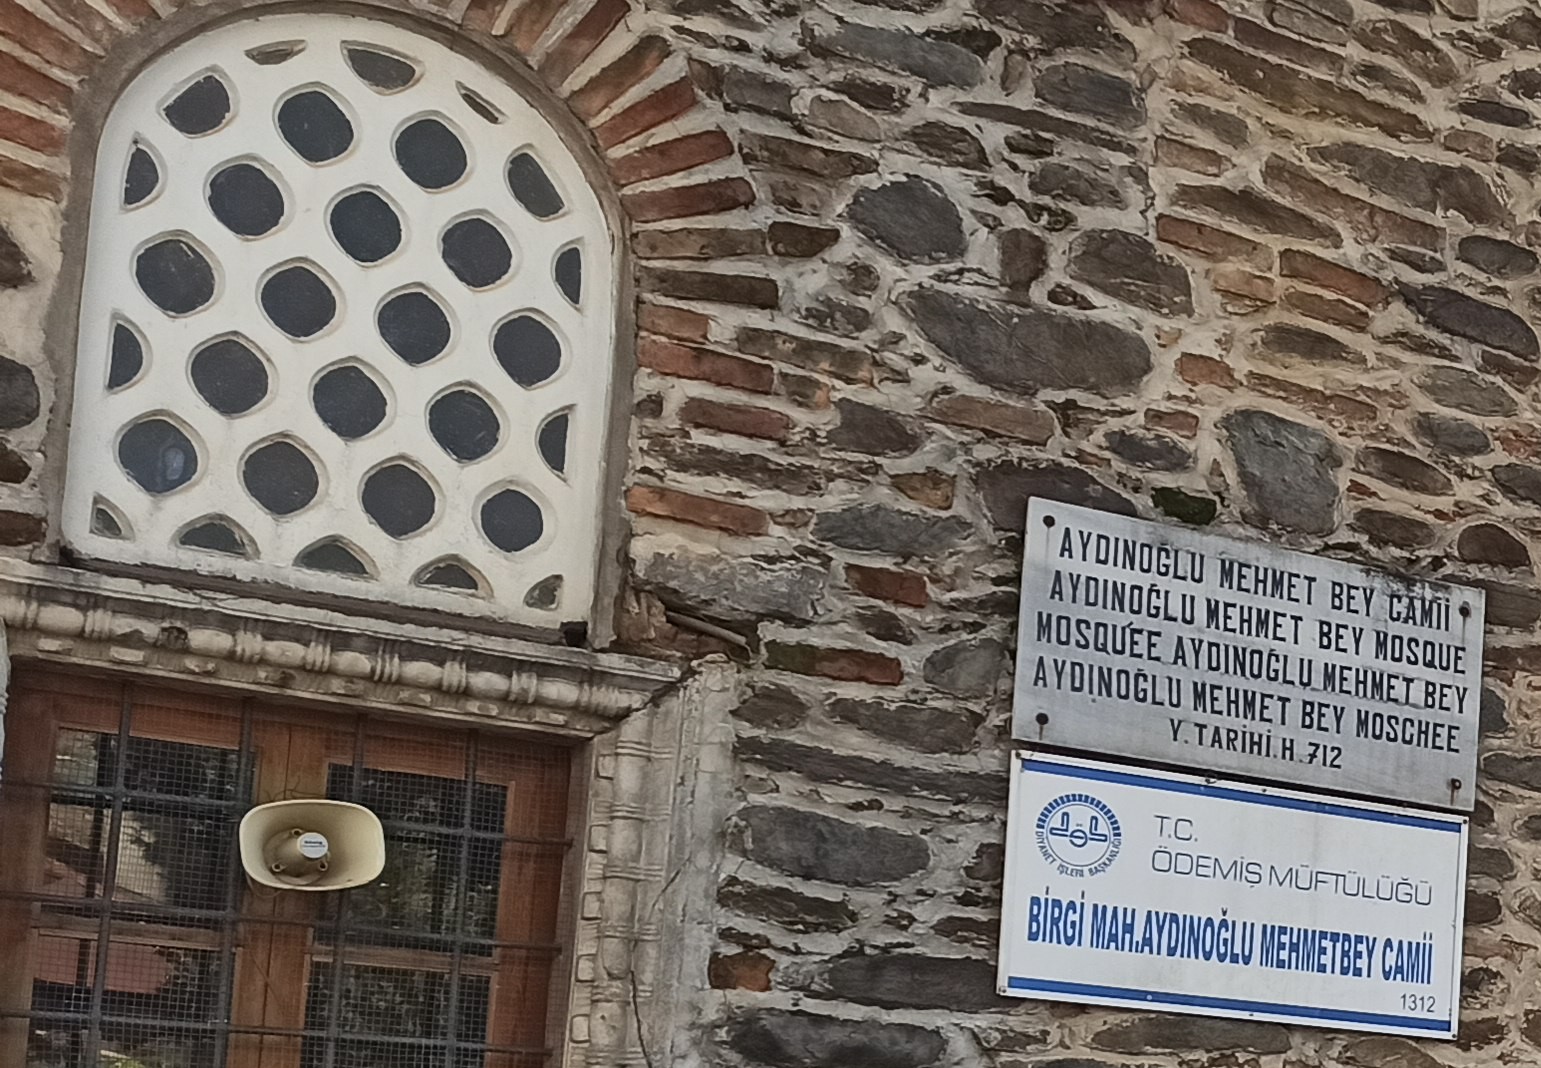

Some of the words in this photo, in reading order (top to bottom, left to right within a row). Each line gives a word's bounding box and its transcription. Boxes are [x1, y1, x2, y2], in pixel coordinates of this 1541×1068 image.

[1050, 570, 1195, 625] AYDINOĞLU
[1206, 598, 1303, 644] MEHMET
[1319, 620, 1364, 655] BEY
[1374, 630, 1466, 674] MOSQUE
[1060, 527, 1204, 583] AYDINOĞLU
[1220, 559, 1316, 605] MEHMET
[1332, 581, 1374, 617] BEY
[1388, 594, 1450, 632] CAMİİ
[1033, 656, 1181, 708] AYDINOĞLU
[1193, 681, 1291, 725] MEHMET
[1302, 699, 1345, 734] BEY
[1356, 709, 1460, 753] MOSCHEE
[1037, 611, 1161, 662] MOSQUÉE
[1172, 636, 1312, 689] AYDINOĞLU
[1323, 663, 1417, 708] MEHMET
[1424, 681, 1467, 713] BEY
[1152, 845, 1262, 888] ÖDEMİŞ
[1269, 864, 1433, 906] MÜFTÜLÜĞÜ
[1154, 815, 1198, 842] T.C.
[1027, 886, 1084, 947] BİRGİ
[1260, 923, 1377, 979] MEHMETBEY
[1382, 931, 1433, 985] CAMİİ
[1400, 993, 1436, 1013] 1312
